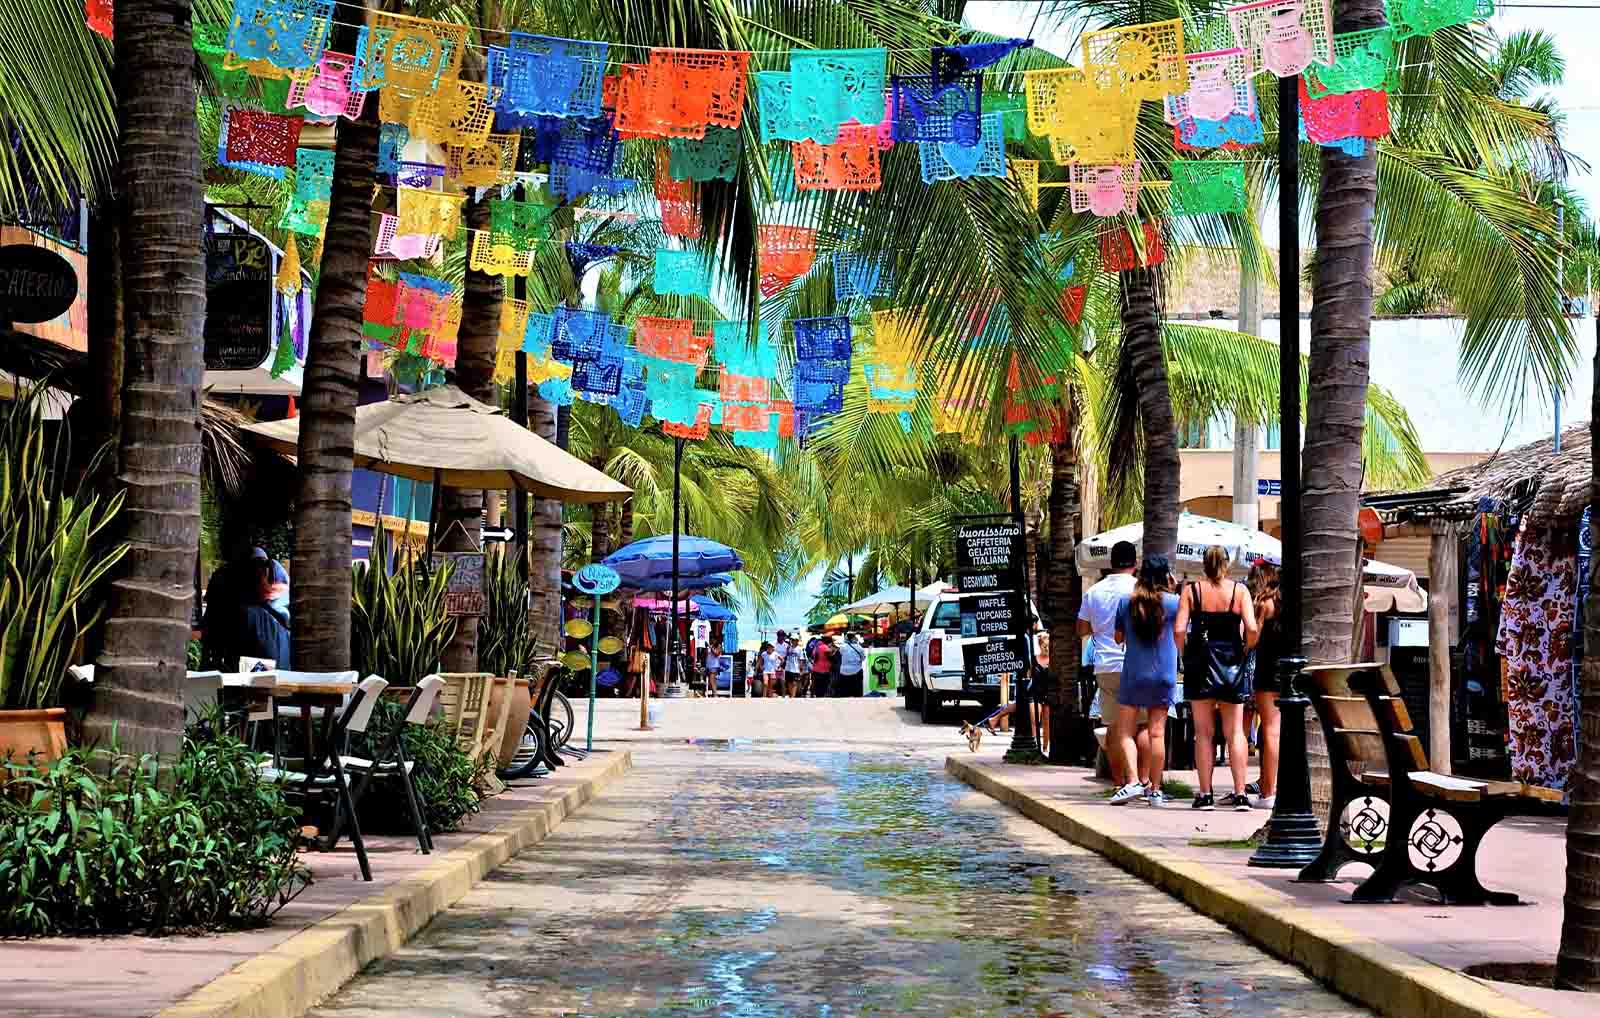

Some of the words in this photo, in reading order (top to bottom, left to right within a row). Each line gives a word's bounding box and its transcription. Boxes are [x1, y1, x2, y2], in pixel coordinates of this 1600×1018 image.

[234, 239, 267, 269] Big
[0, 267, 72, 298] CATERIN
[959, 526, 1019, 538] buonissimo
[966, 537, 1012, 547] CAFFETERIA
[968, 546, 1011, 557] GELATERIA
[972, 556, 1009, 566] ITALIANA
[963, 575, 998, 588] DESAYUNOS
[978, 598, 1006, 608] WAFFLE
[976, 609, 1012, 620] CUPCAKES
[980, 621, 1008, 632] CREPAS
[986, 642, 1005, 652] CAFE
[978, 651, 1015, 664] ESPRESSO
[975, 659, 1024, 675] FRAPPUCCINO
